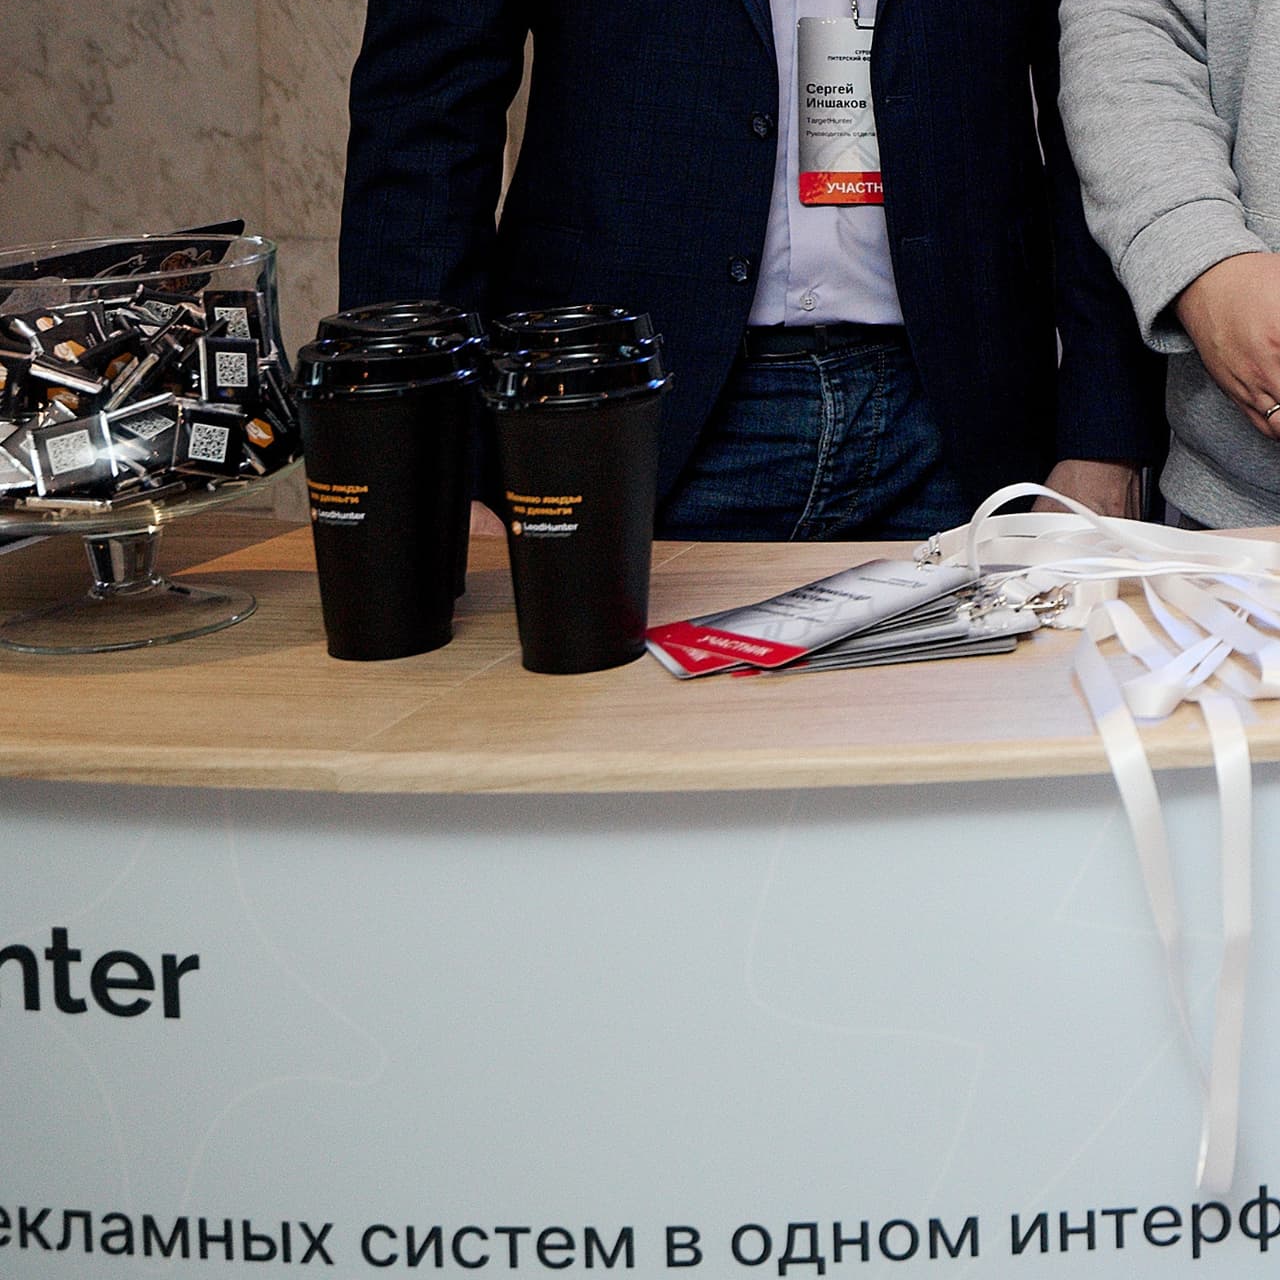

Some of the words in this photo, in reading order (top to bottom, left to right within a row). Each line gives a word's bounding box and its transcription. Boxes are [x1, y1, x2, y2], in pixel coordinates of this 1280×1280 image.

[806, 83, 854, 96] Сергей
[806, 98, 867, 109] Иншаков
[523, 521, 580, 532] LeadHunter
[0, 1204, 335, 1266] кламных
[360, 1222, 636, 1270] систем
[665, 1224, 703, 1268] в
[730, 1216, 980, 1277] одном
